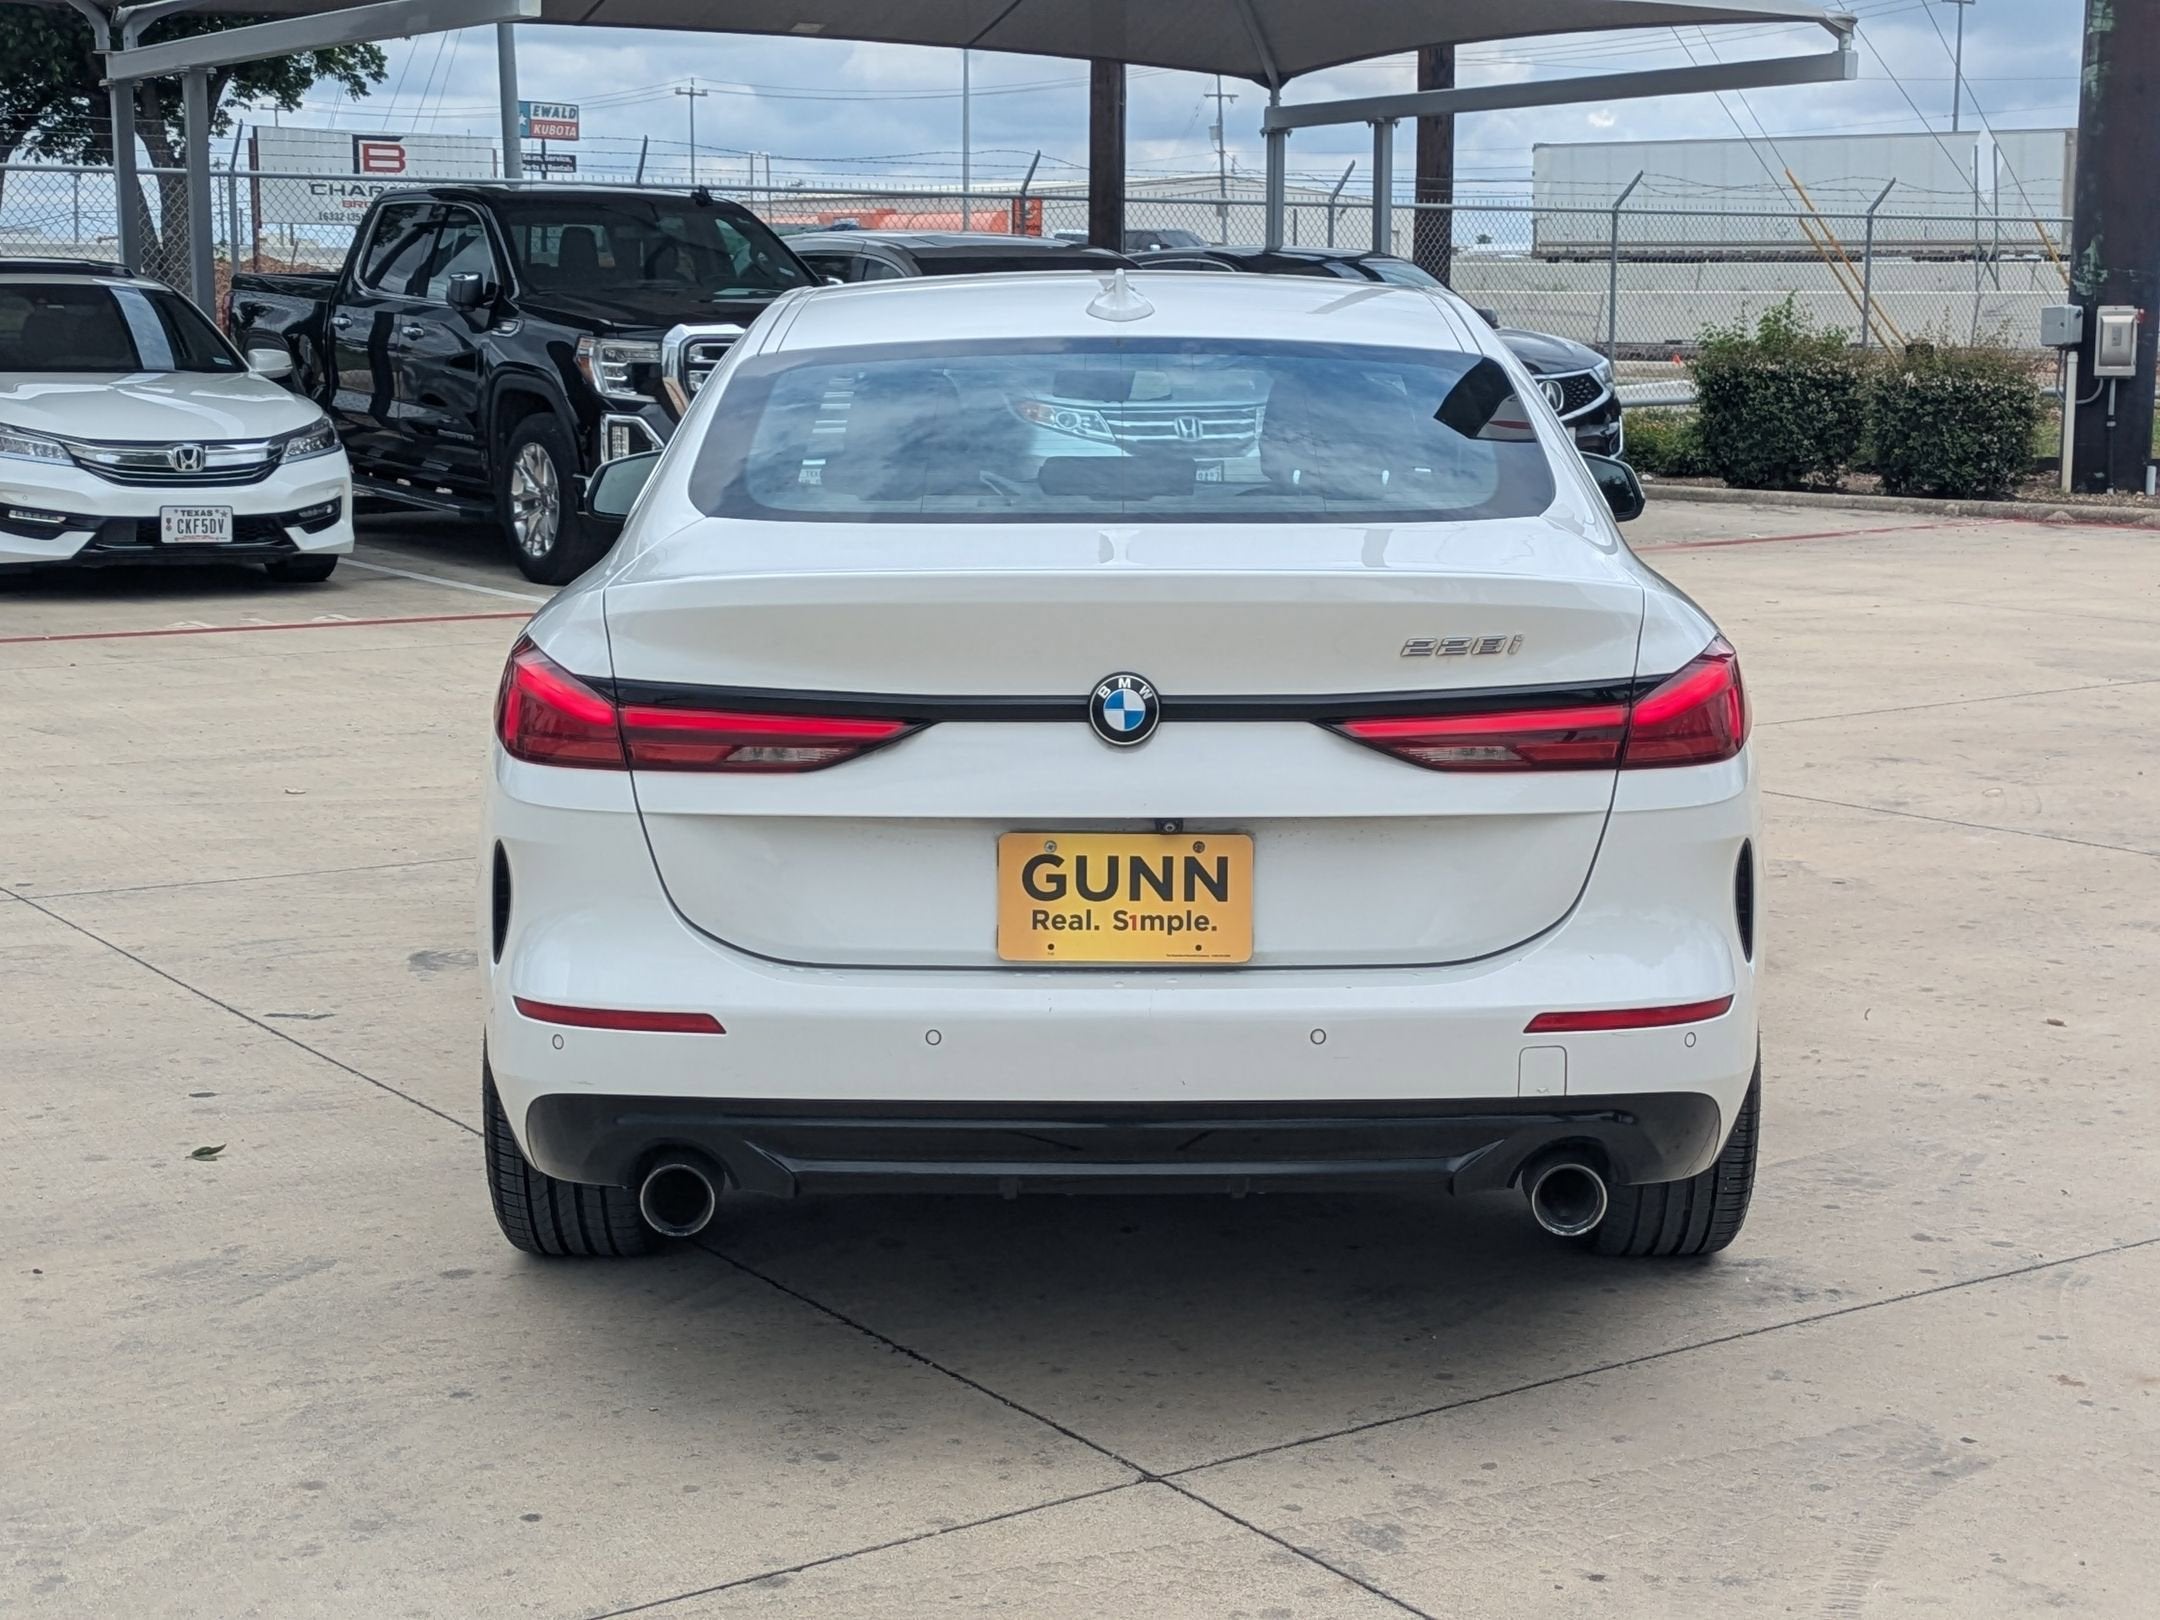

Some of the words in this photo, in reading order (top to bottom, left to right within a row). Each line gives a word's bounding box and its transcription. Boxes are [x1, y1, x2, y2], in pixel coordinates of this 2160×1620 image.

[533, 105, 577, 119] EWALD
[533, 124, 577, 137] KUBOTA
[180, 509, 213, 517] TEXAS
[177, 518, 224, 534] CKF5DV
[1400, 634, 1524, 657] 228i
[1097, 677, 1153, 700] BMW
[1021, 853, 1229, 902] GUNN
[1032, 909, 1100, 931] Real.
